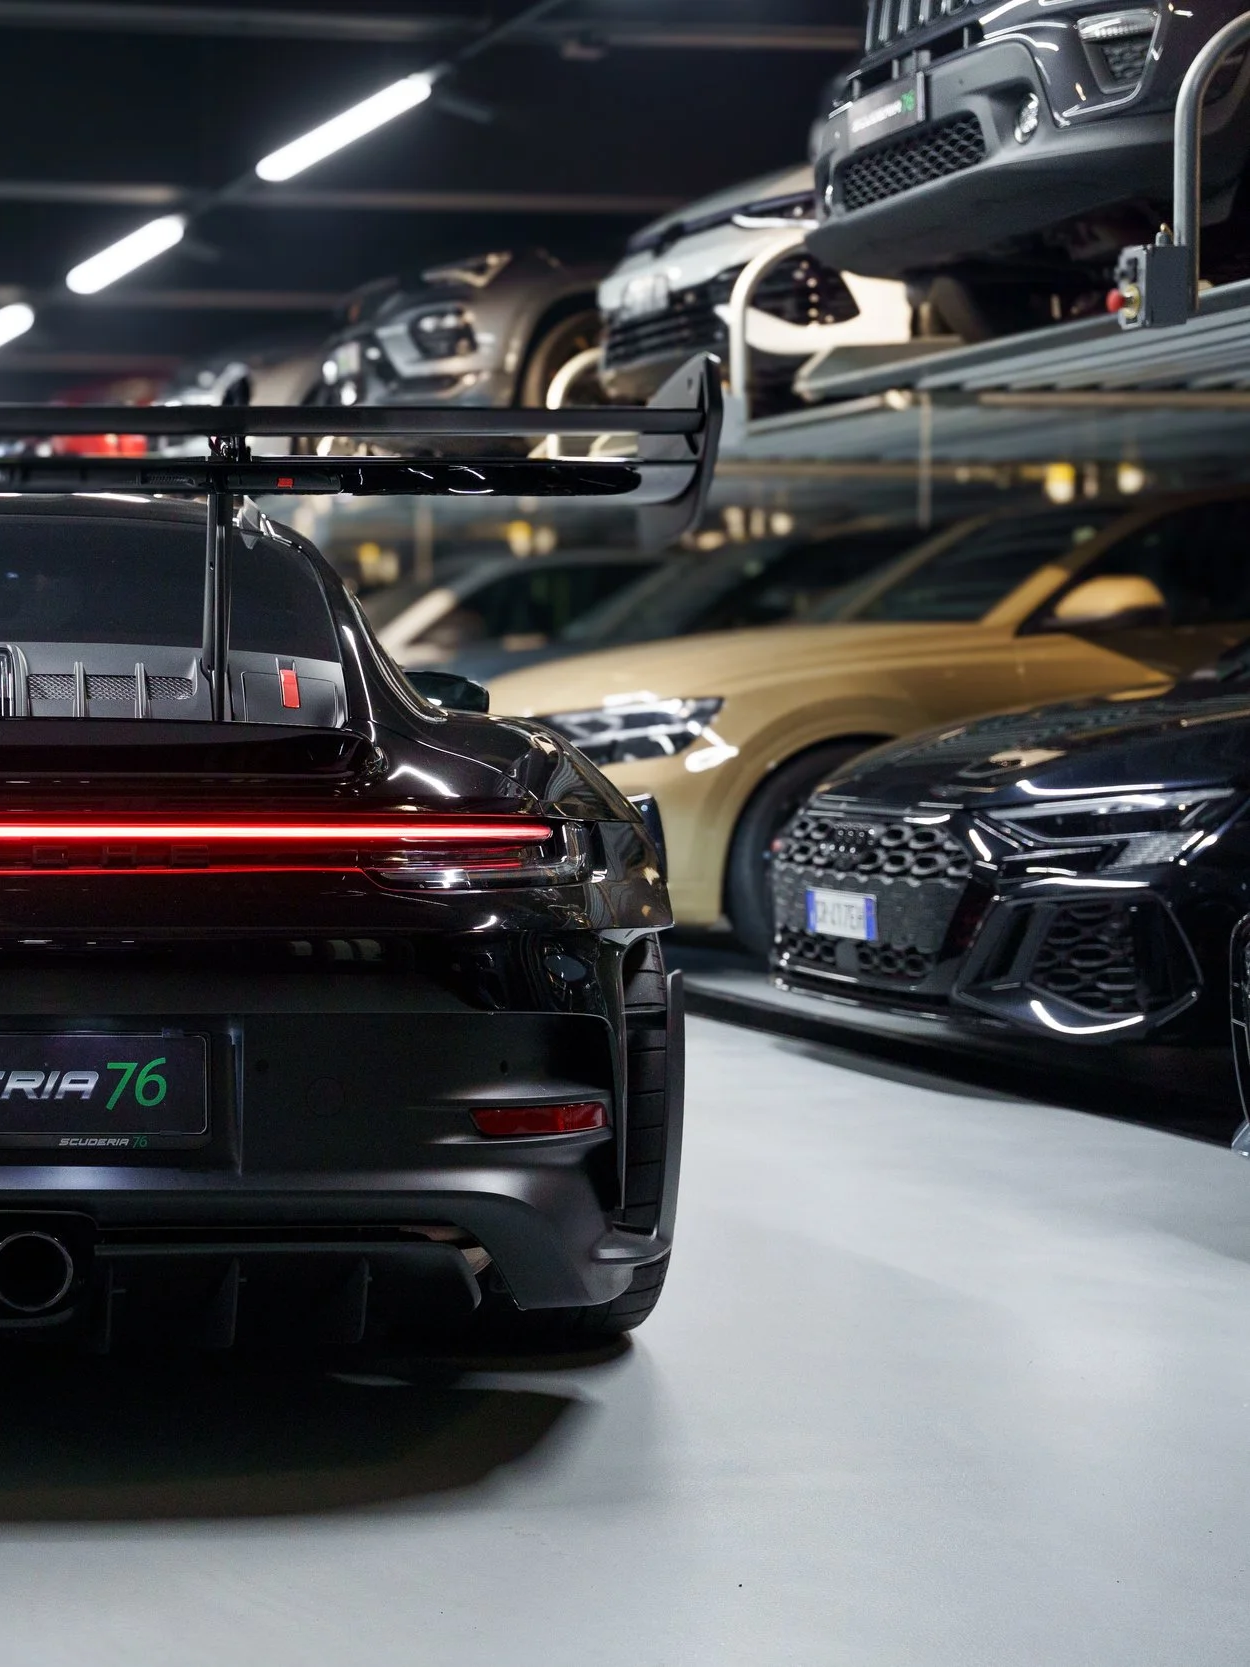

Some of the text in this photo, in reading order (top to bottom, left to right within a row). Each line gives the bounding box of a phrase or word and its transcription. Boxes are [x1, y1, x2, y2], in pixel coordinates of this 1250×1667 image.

[105, 1057, 167, 1111] 76
[58, 1136, 148, 1149] SCUDERIA 76
